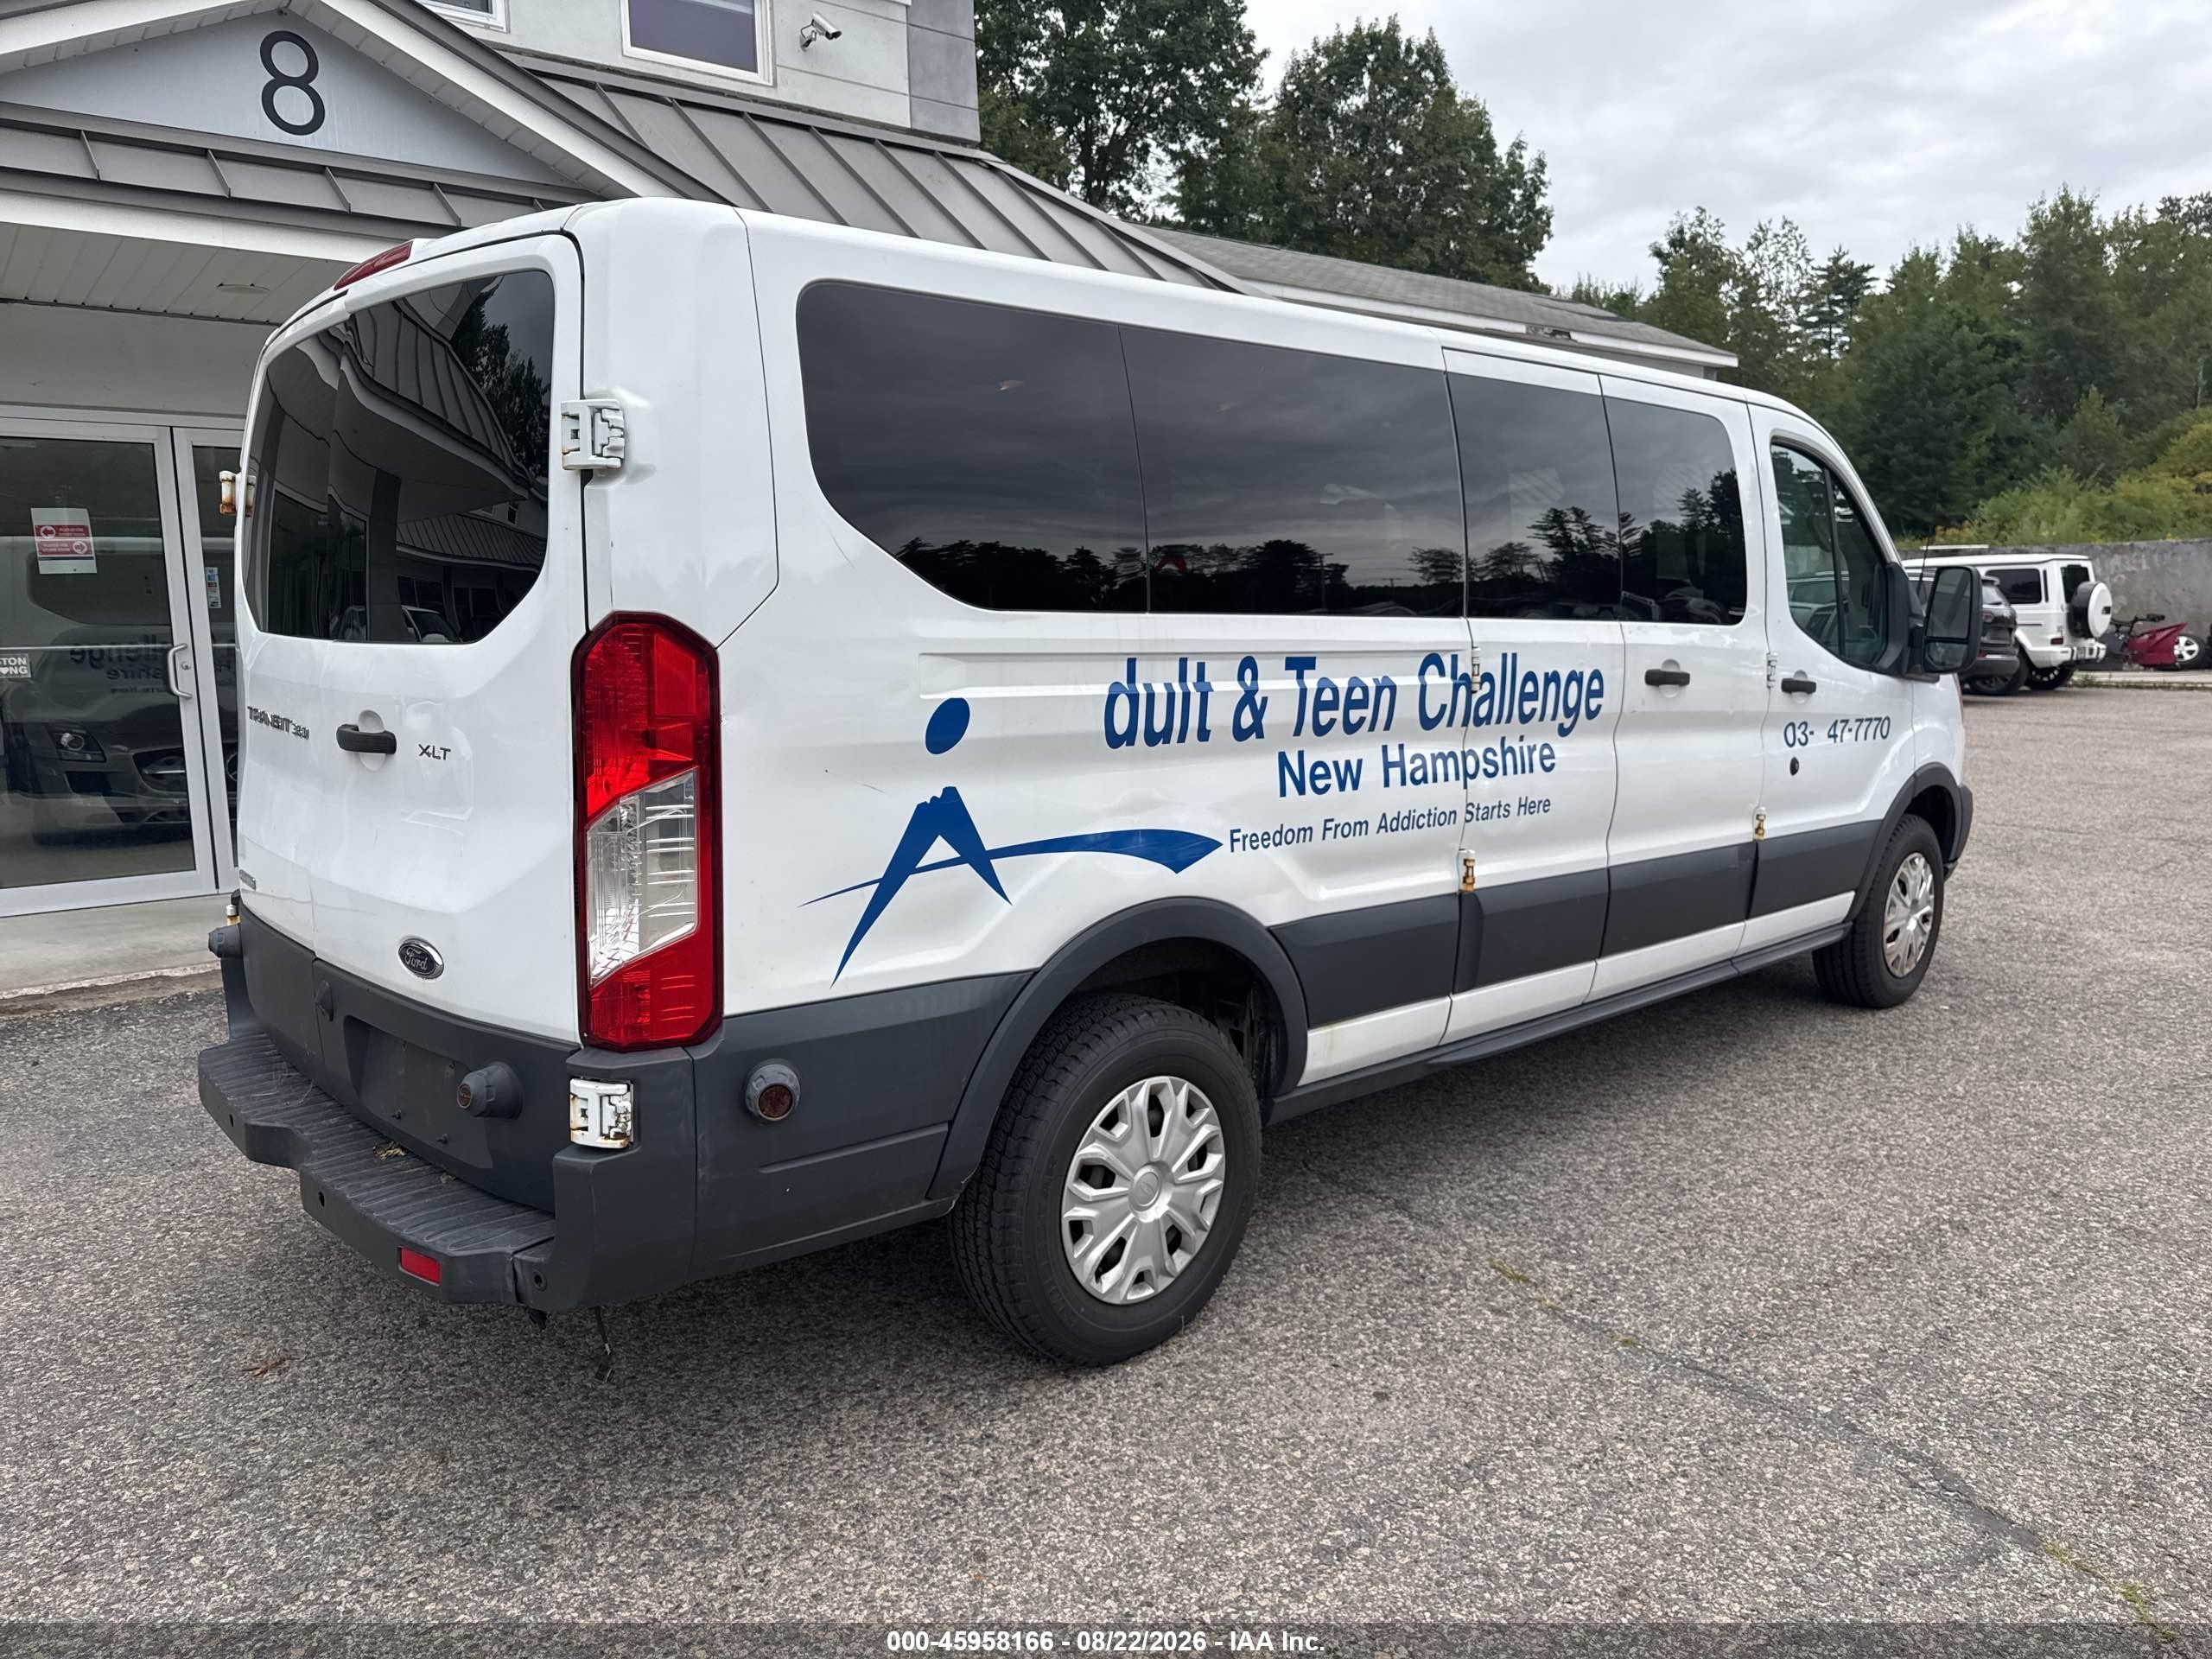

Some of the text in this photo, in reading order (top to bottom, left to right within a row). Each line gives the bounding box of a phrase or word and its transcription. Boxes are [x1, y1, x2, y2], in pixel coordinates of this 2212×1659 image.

[260, 30, 325, 136] 8
[1104, 652, 1604, 749] dult & Teen Challenge
[1827, 715, 1891, 743] 47-7770
[418, 744, 451, 760] XLT
[1278, 735, 1555, 798] New Hampshire
[1230, 796, 1551, 853] Freedom From Addiction Starts Here
[405, 947, 429, 970] Ford
